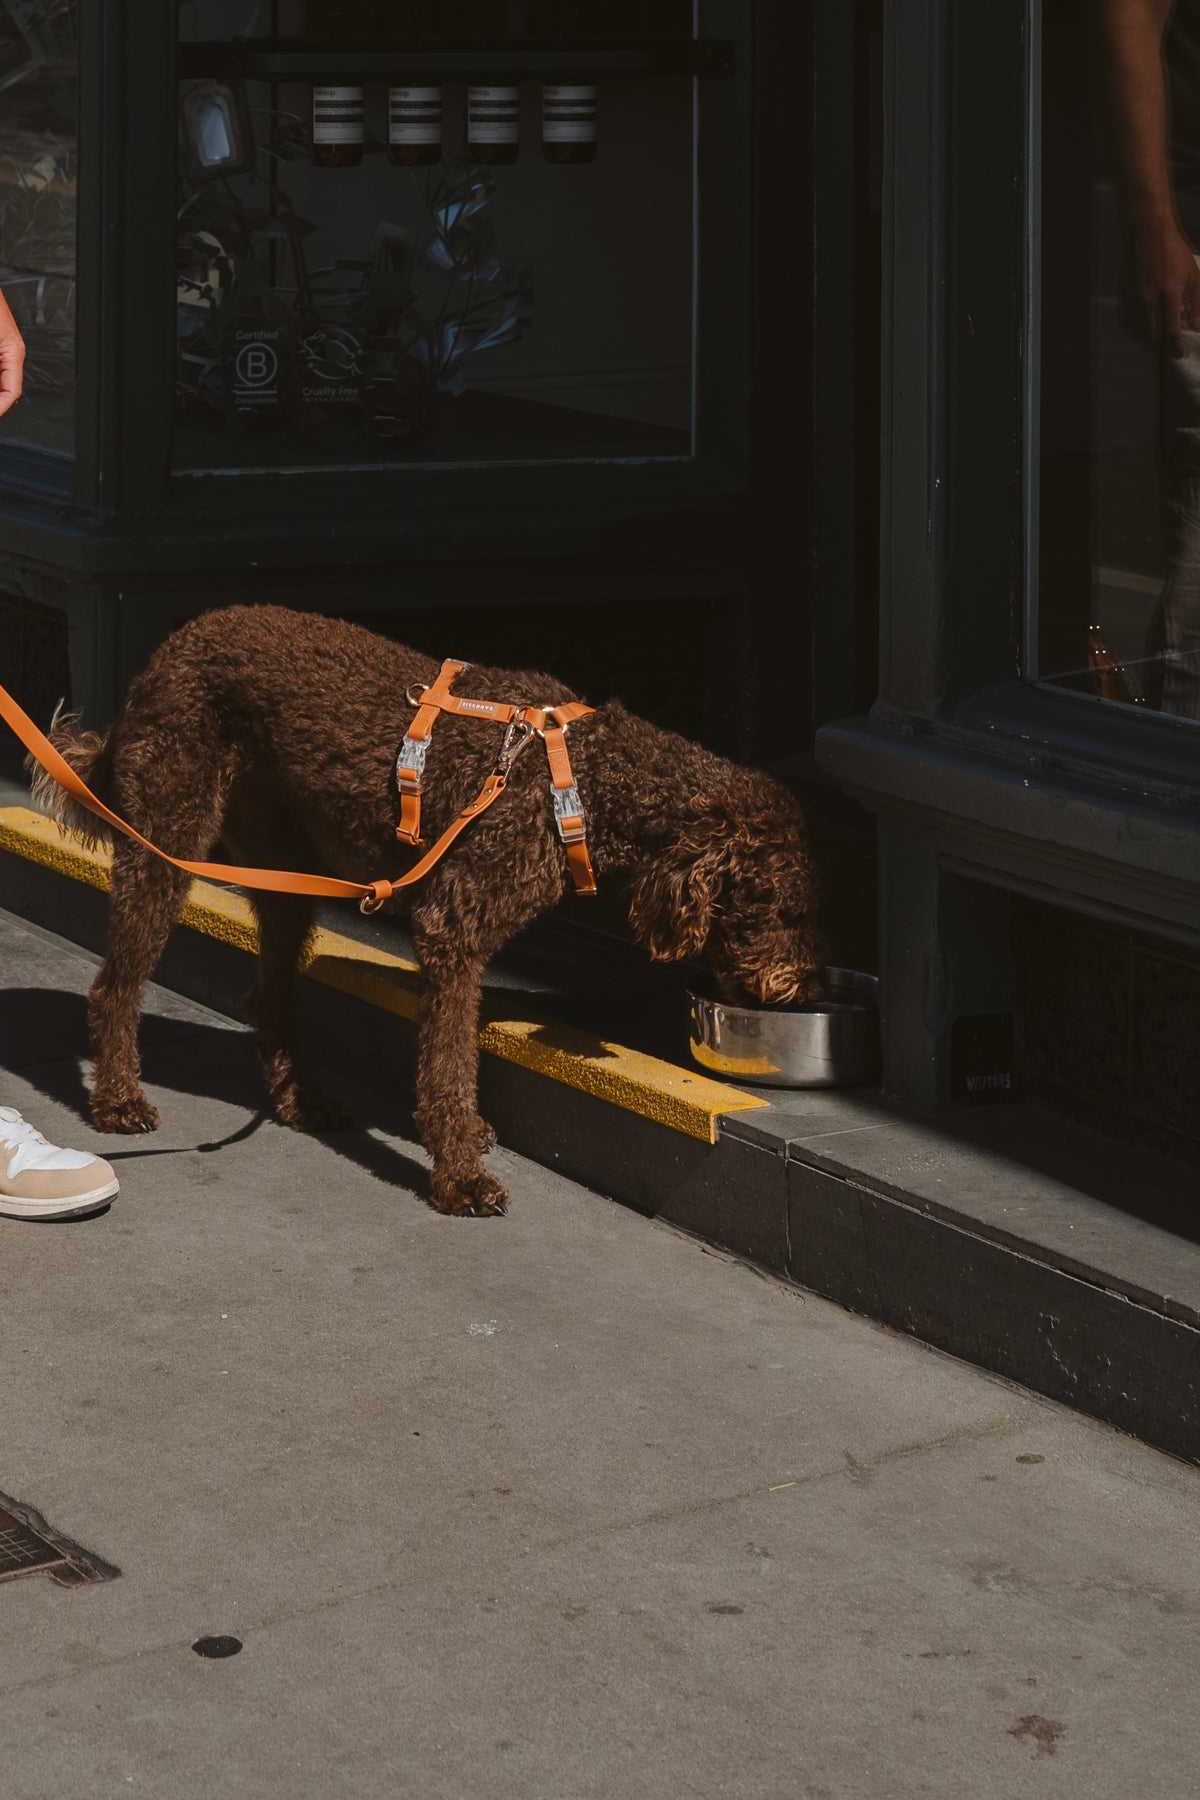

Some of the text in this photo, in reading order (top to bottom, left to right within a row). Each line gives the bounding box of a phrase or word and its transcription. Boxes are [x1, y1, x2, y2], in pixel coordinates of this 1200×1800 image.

[235, 329, 279, 340] Certified
[302, 386, 360, 398] Cruelty Free
